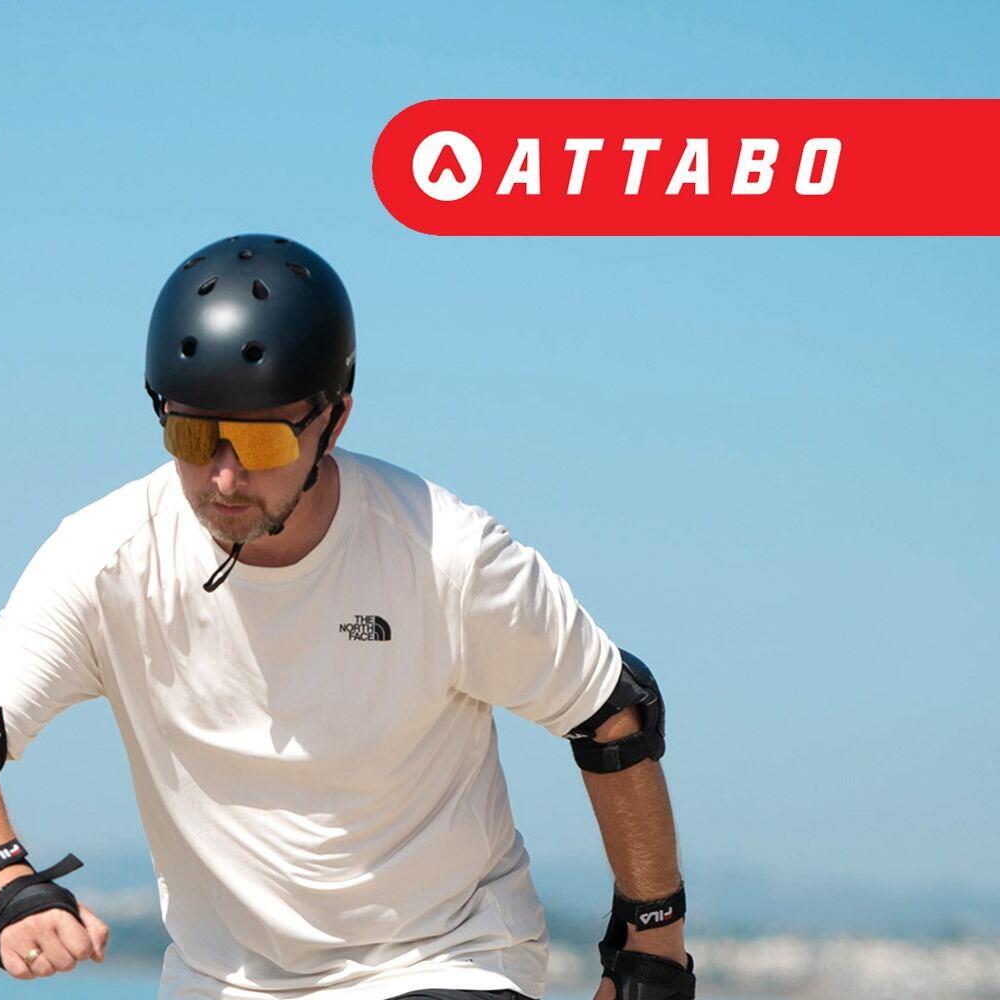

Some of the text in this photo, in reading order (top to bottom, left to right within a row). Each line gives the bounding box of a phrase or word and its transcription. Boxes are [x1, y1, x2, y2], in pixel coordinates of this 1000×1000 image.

[354, 615, 374, 624] THE
[339, 623, 374, 633] NORTH
[348, 631, 374, 641] FACE
[640, 906, 674, 925] FILA
